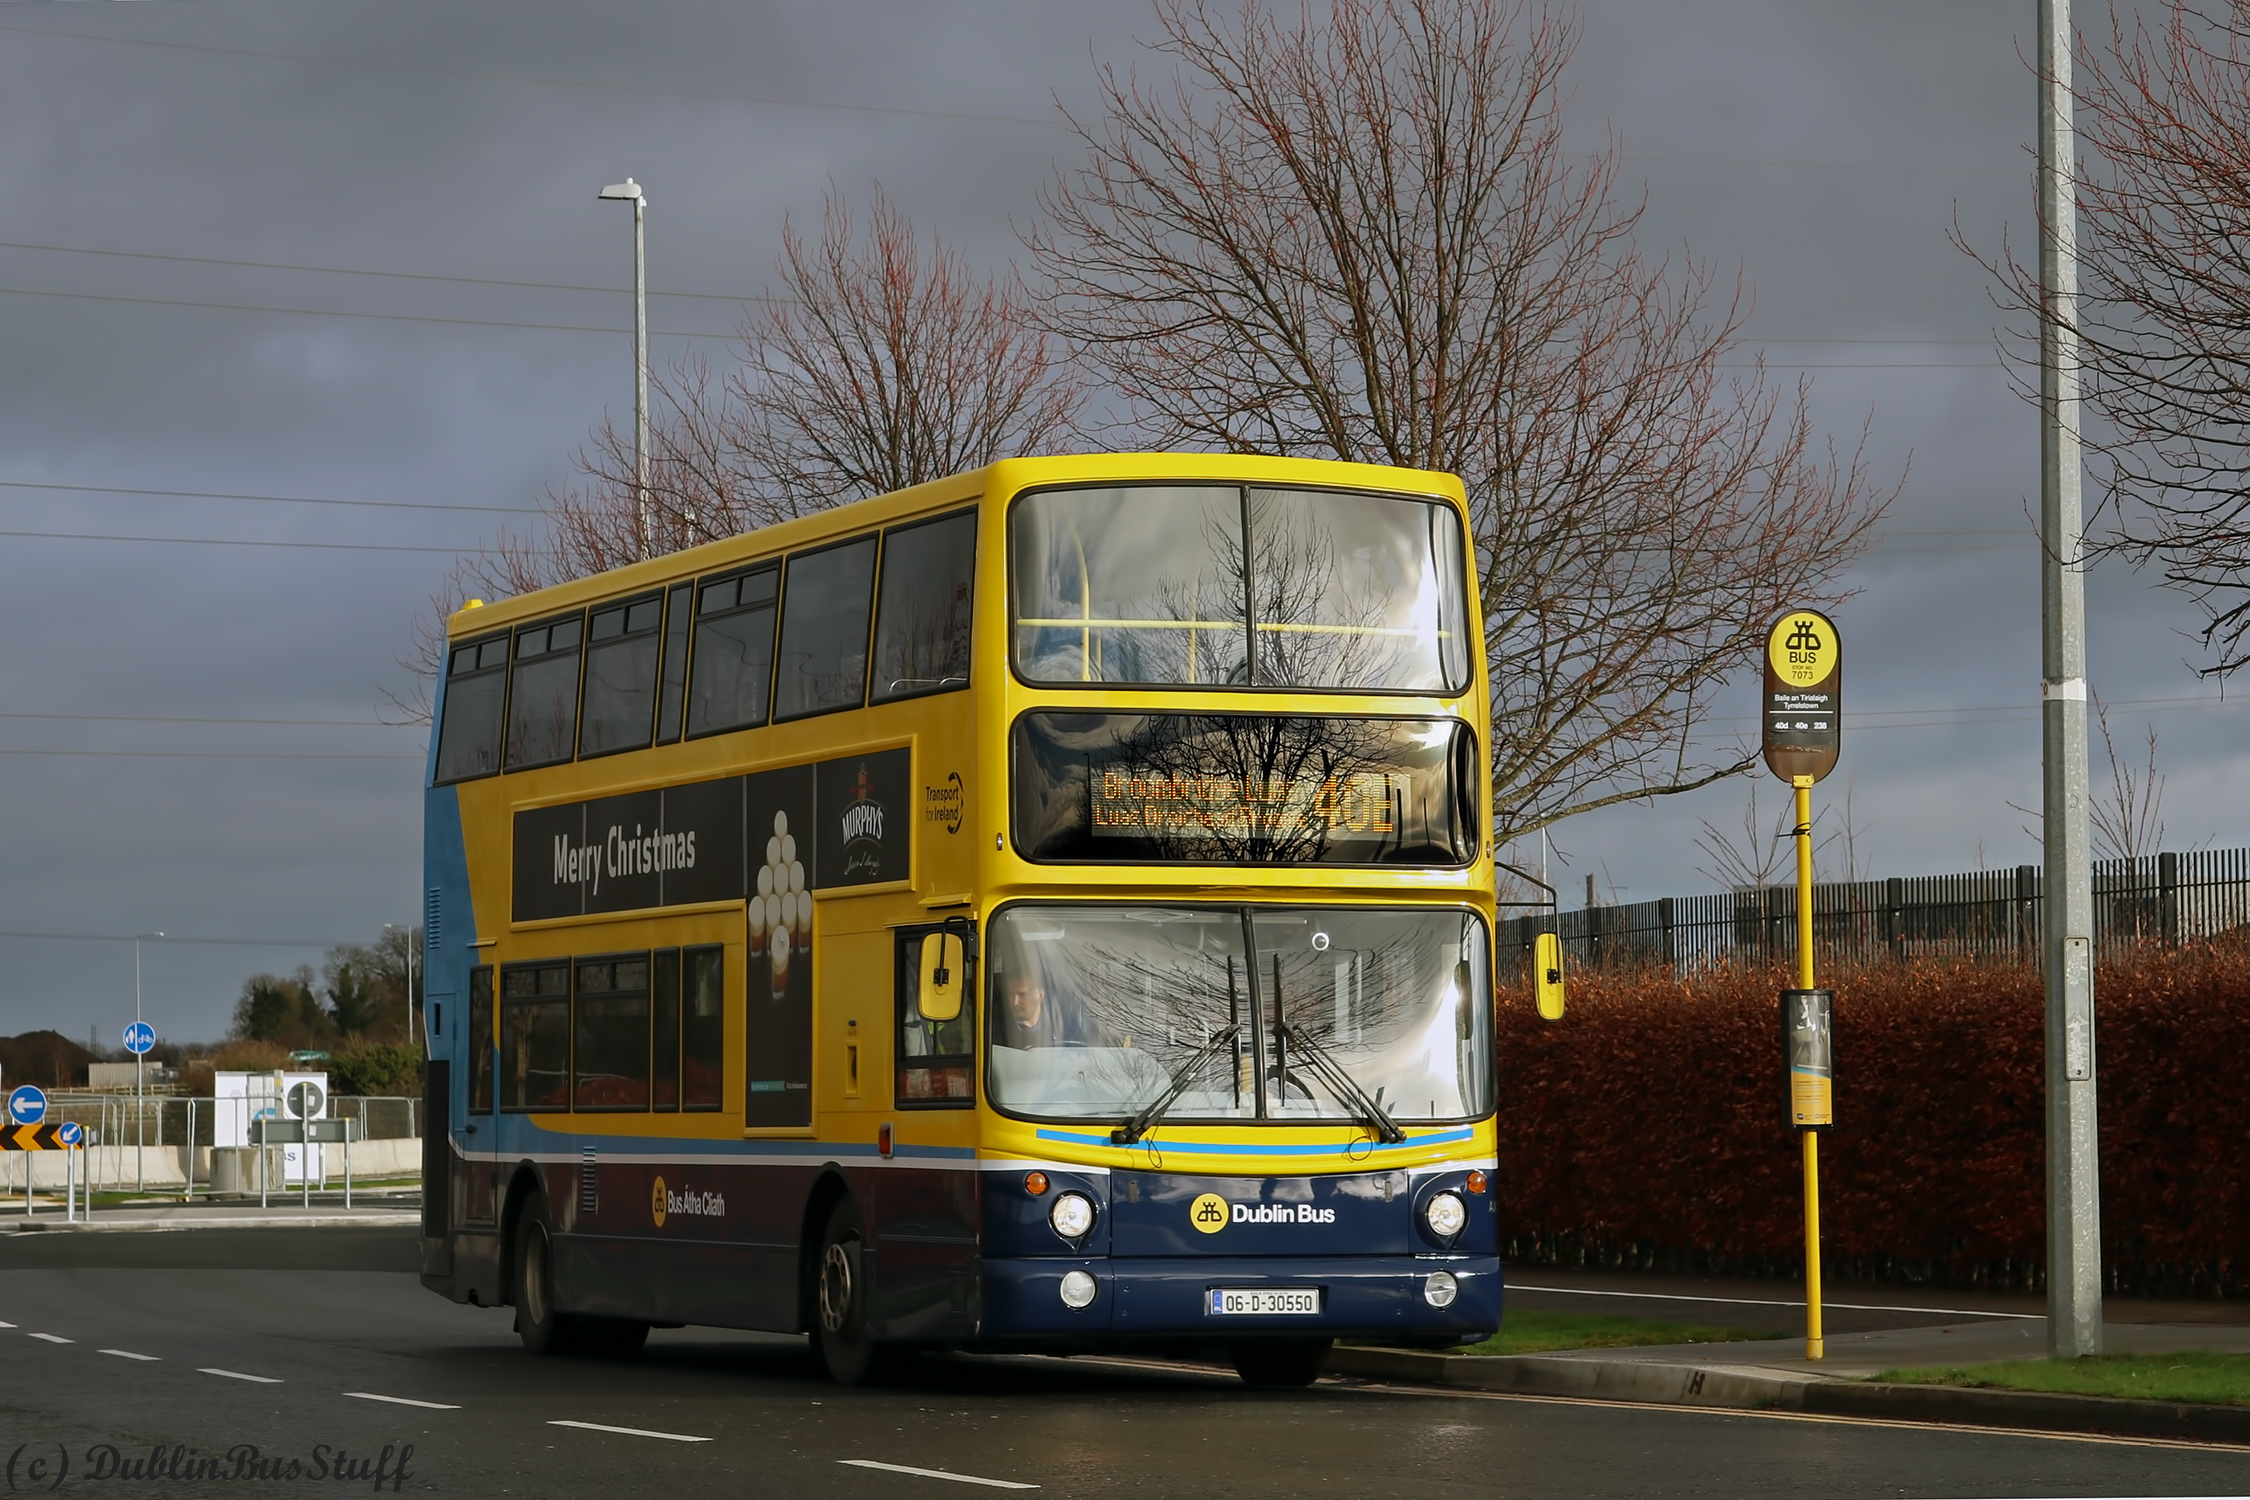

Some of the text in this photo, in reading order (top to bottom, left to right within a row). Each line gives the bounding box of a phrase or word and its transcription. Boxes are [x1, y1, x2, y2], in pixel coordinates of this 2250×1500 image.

[1789, 652, 1816, 664] BUS
[1792, 671, 1814, 680] 7073
[1774, 694, 1790, 702] Baile
[1774, 721, 1828, 730] 40d 40e 238
[925, 786, 959, 803] Transport
[925, 805, 959, 821] for Ireland
[1096, 804, 1141, 826] Luas
[553, 823, 696, 896] Merry Christmas
[667, 1184, 725, 1217] Bus Átha Cliath
[1232, 1204, 1336, 1223] Dublin Bus
[1226, 1295, 1312, 1312] 06-D-30550
